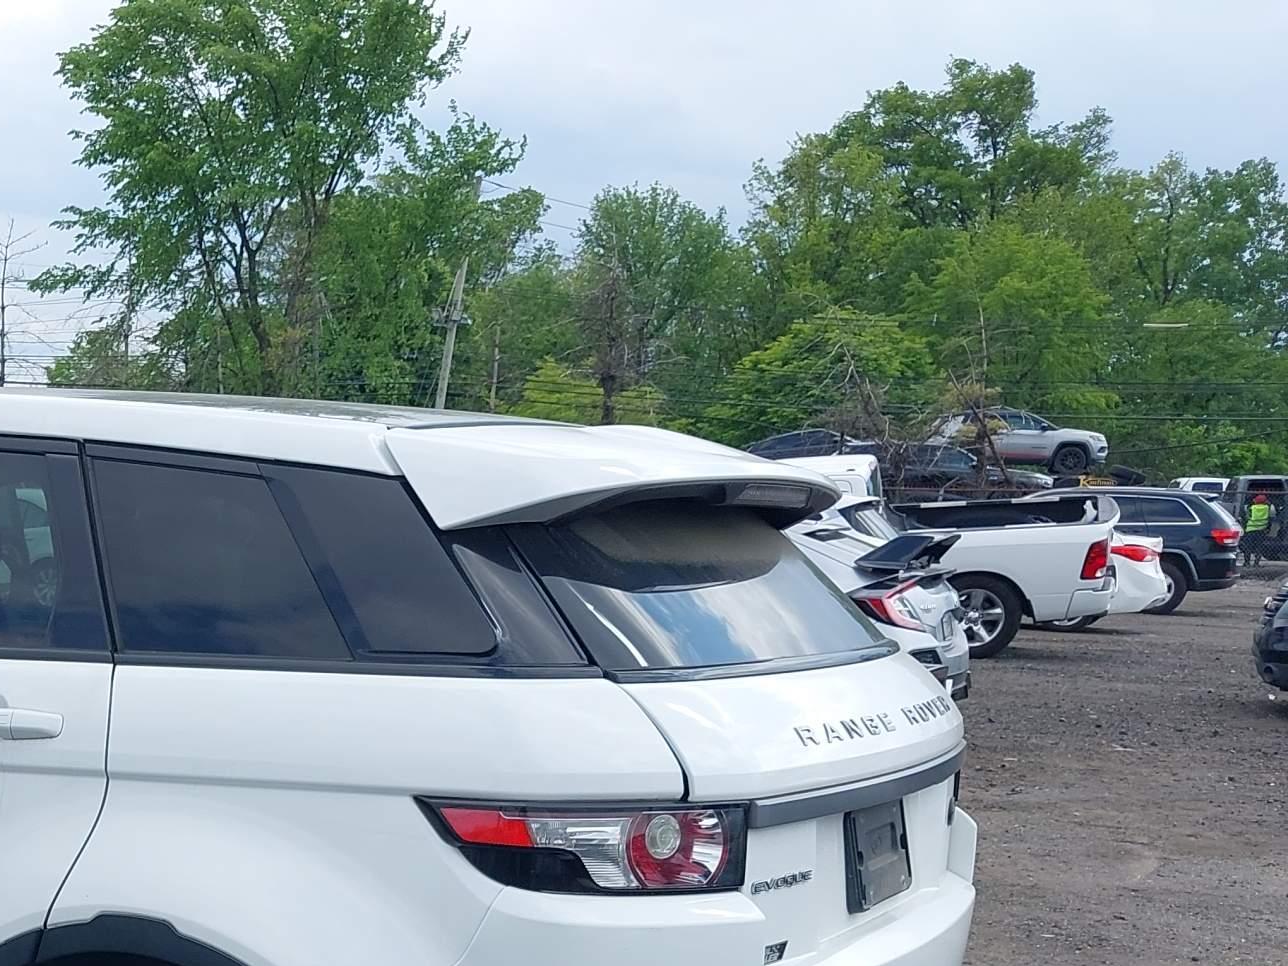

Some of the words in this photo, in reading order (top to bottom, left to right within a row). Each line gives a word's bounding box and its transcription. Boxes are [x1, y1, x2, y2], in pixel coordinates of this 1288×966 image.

[793, 712, 896, 747] RANGE
[900, 695, 951, 726] ROVER
[750, 869, 813, 895] EVOQUE
